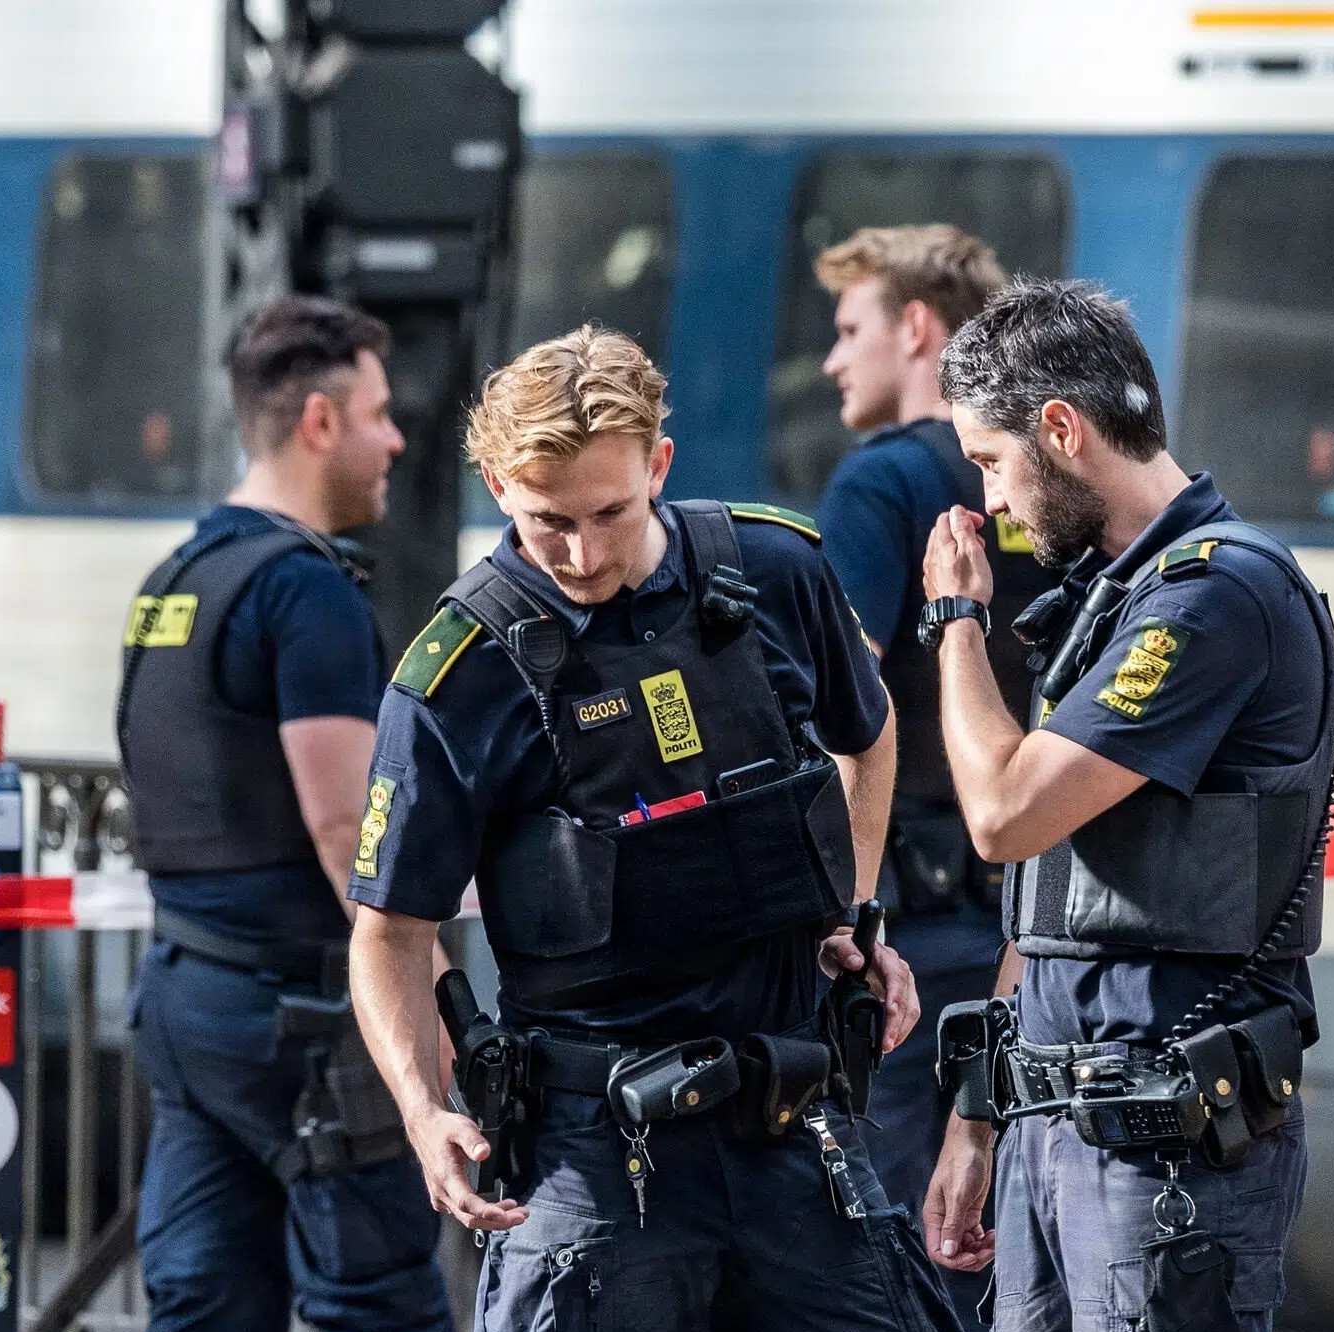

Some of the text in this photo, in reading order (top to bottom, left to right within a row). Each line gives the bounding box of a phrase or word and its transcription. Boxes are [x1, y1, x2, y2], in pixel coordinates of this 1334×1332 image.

[579, 698, 627, 722] G2031
[1097, 689, 1143, 717] POLITI
[665, 739, 697, 754] POLITI
